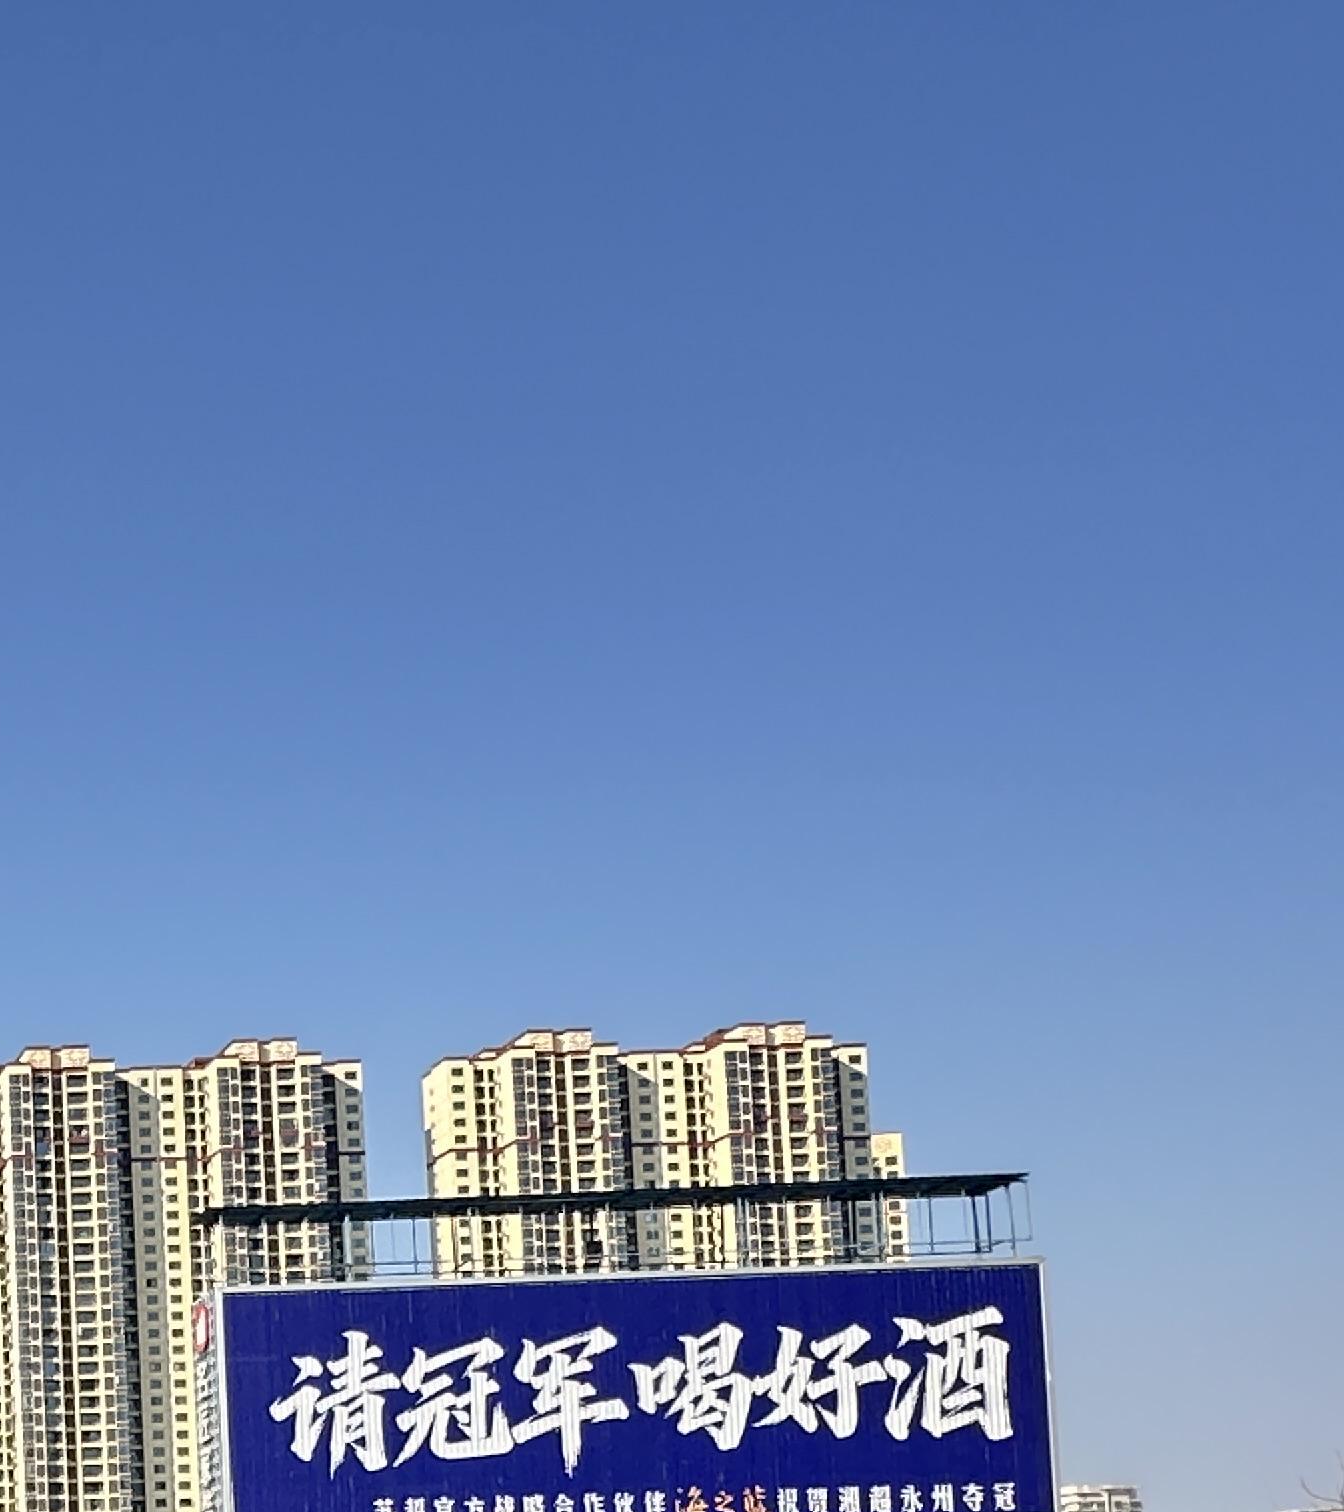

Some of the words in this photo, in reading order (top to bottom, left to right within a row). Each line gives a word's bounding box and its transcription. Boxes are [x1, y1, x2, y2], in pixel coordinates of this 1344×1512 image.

[268, 1306, 1014, 1480] 请冠军喝好酒
